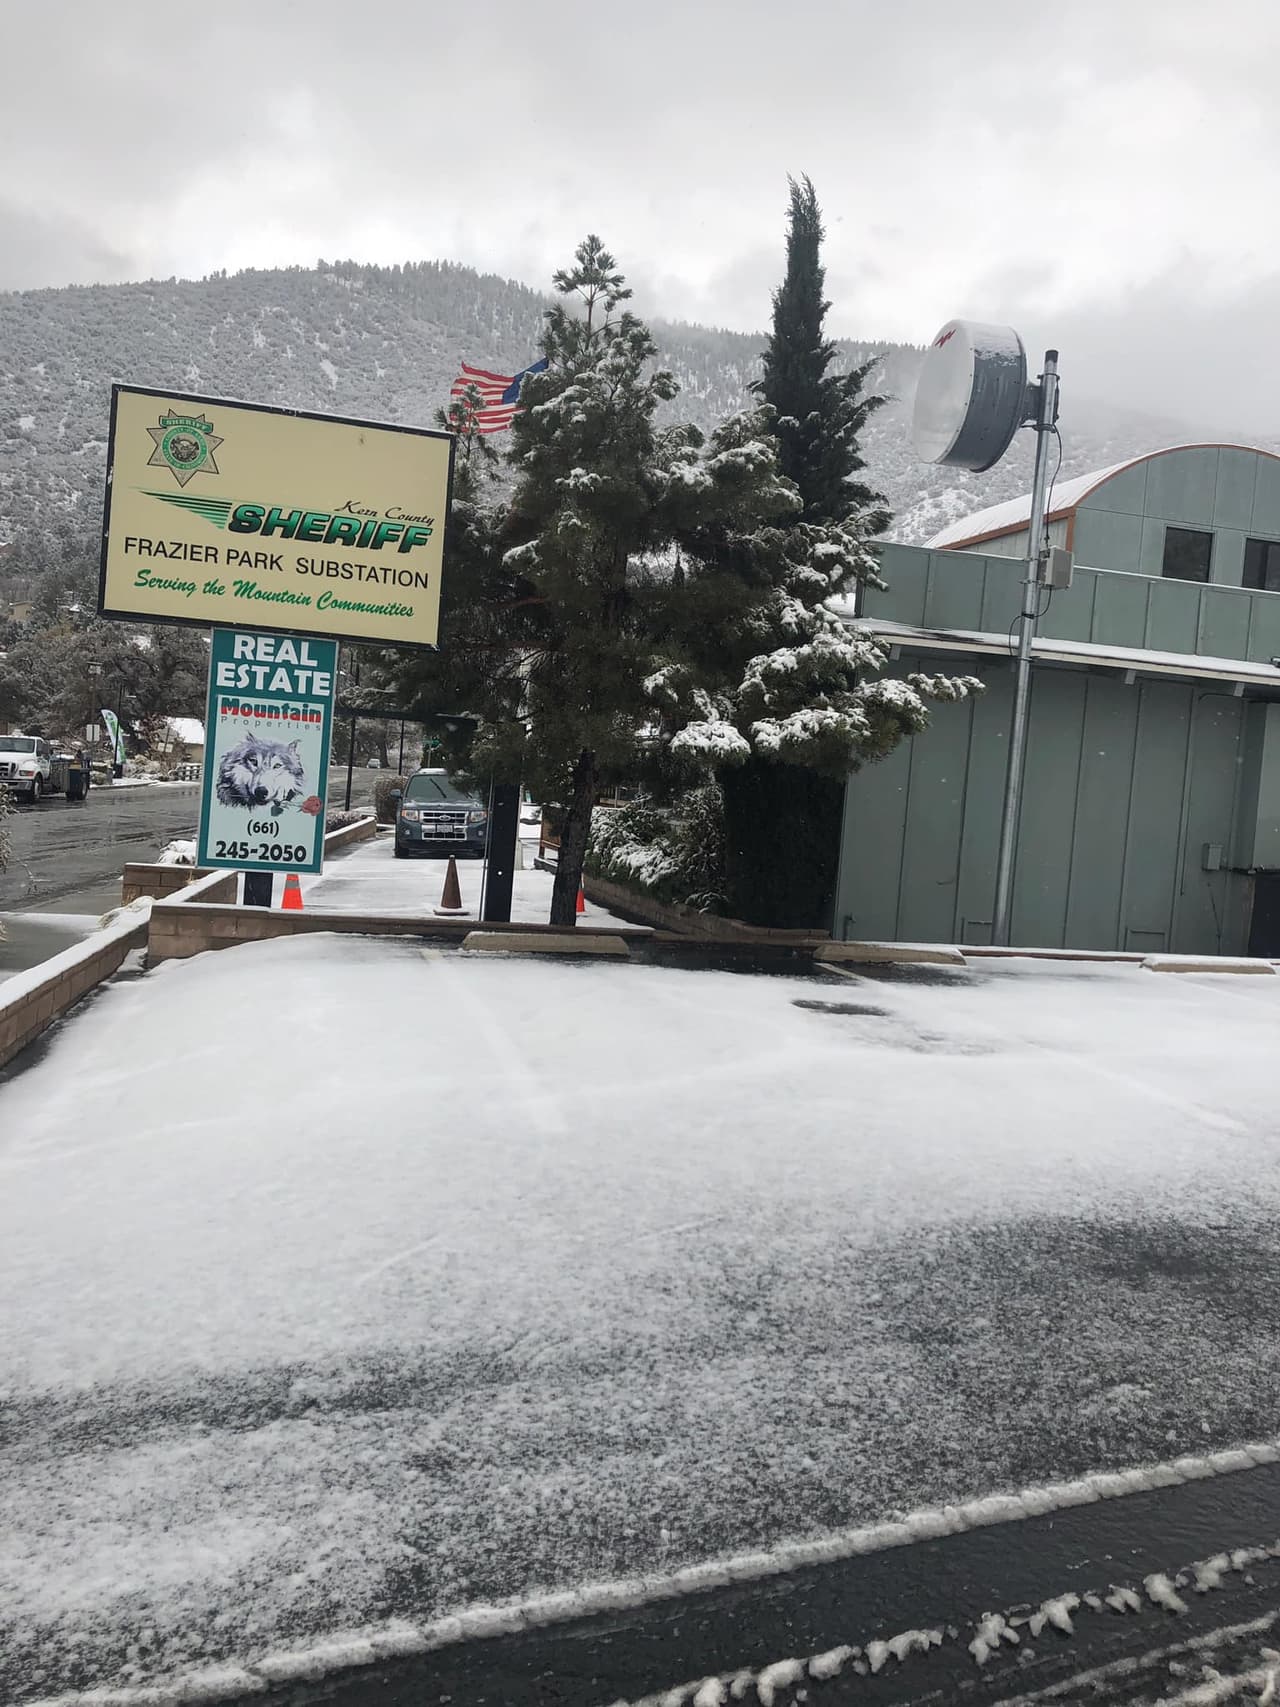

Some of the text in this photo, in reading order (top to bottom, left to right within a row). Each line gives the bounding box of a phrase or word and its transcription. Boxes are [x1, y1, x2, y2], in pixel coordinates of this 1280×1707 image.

[228, 504, 433, 553] SHERIFF
[334, 500, 435, 527] Kern County
[124, 537, 429, 589] FRAZIER PARK SUBSTATION
[134, 569, 414, 617] Serving the Mountain Communities
[233, 634, 318, 667] REAL
[216, 661, 330, 696] ESTATE
[220, 697, 321, 723] Mountain
[220, 716, 321, 731] Properties
[247, 819, 279, 838] (661)
[215, 841, 306, 862] 245-2050
